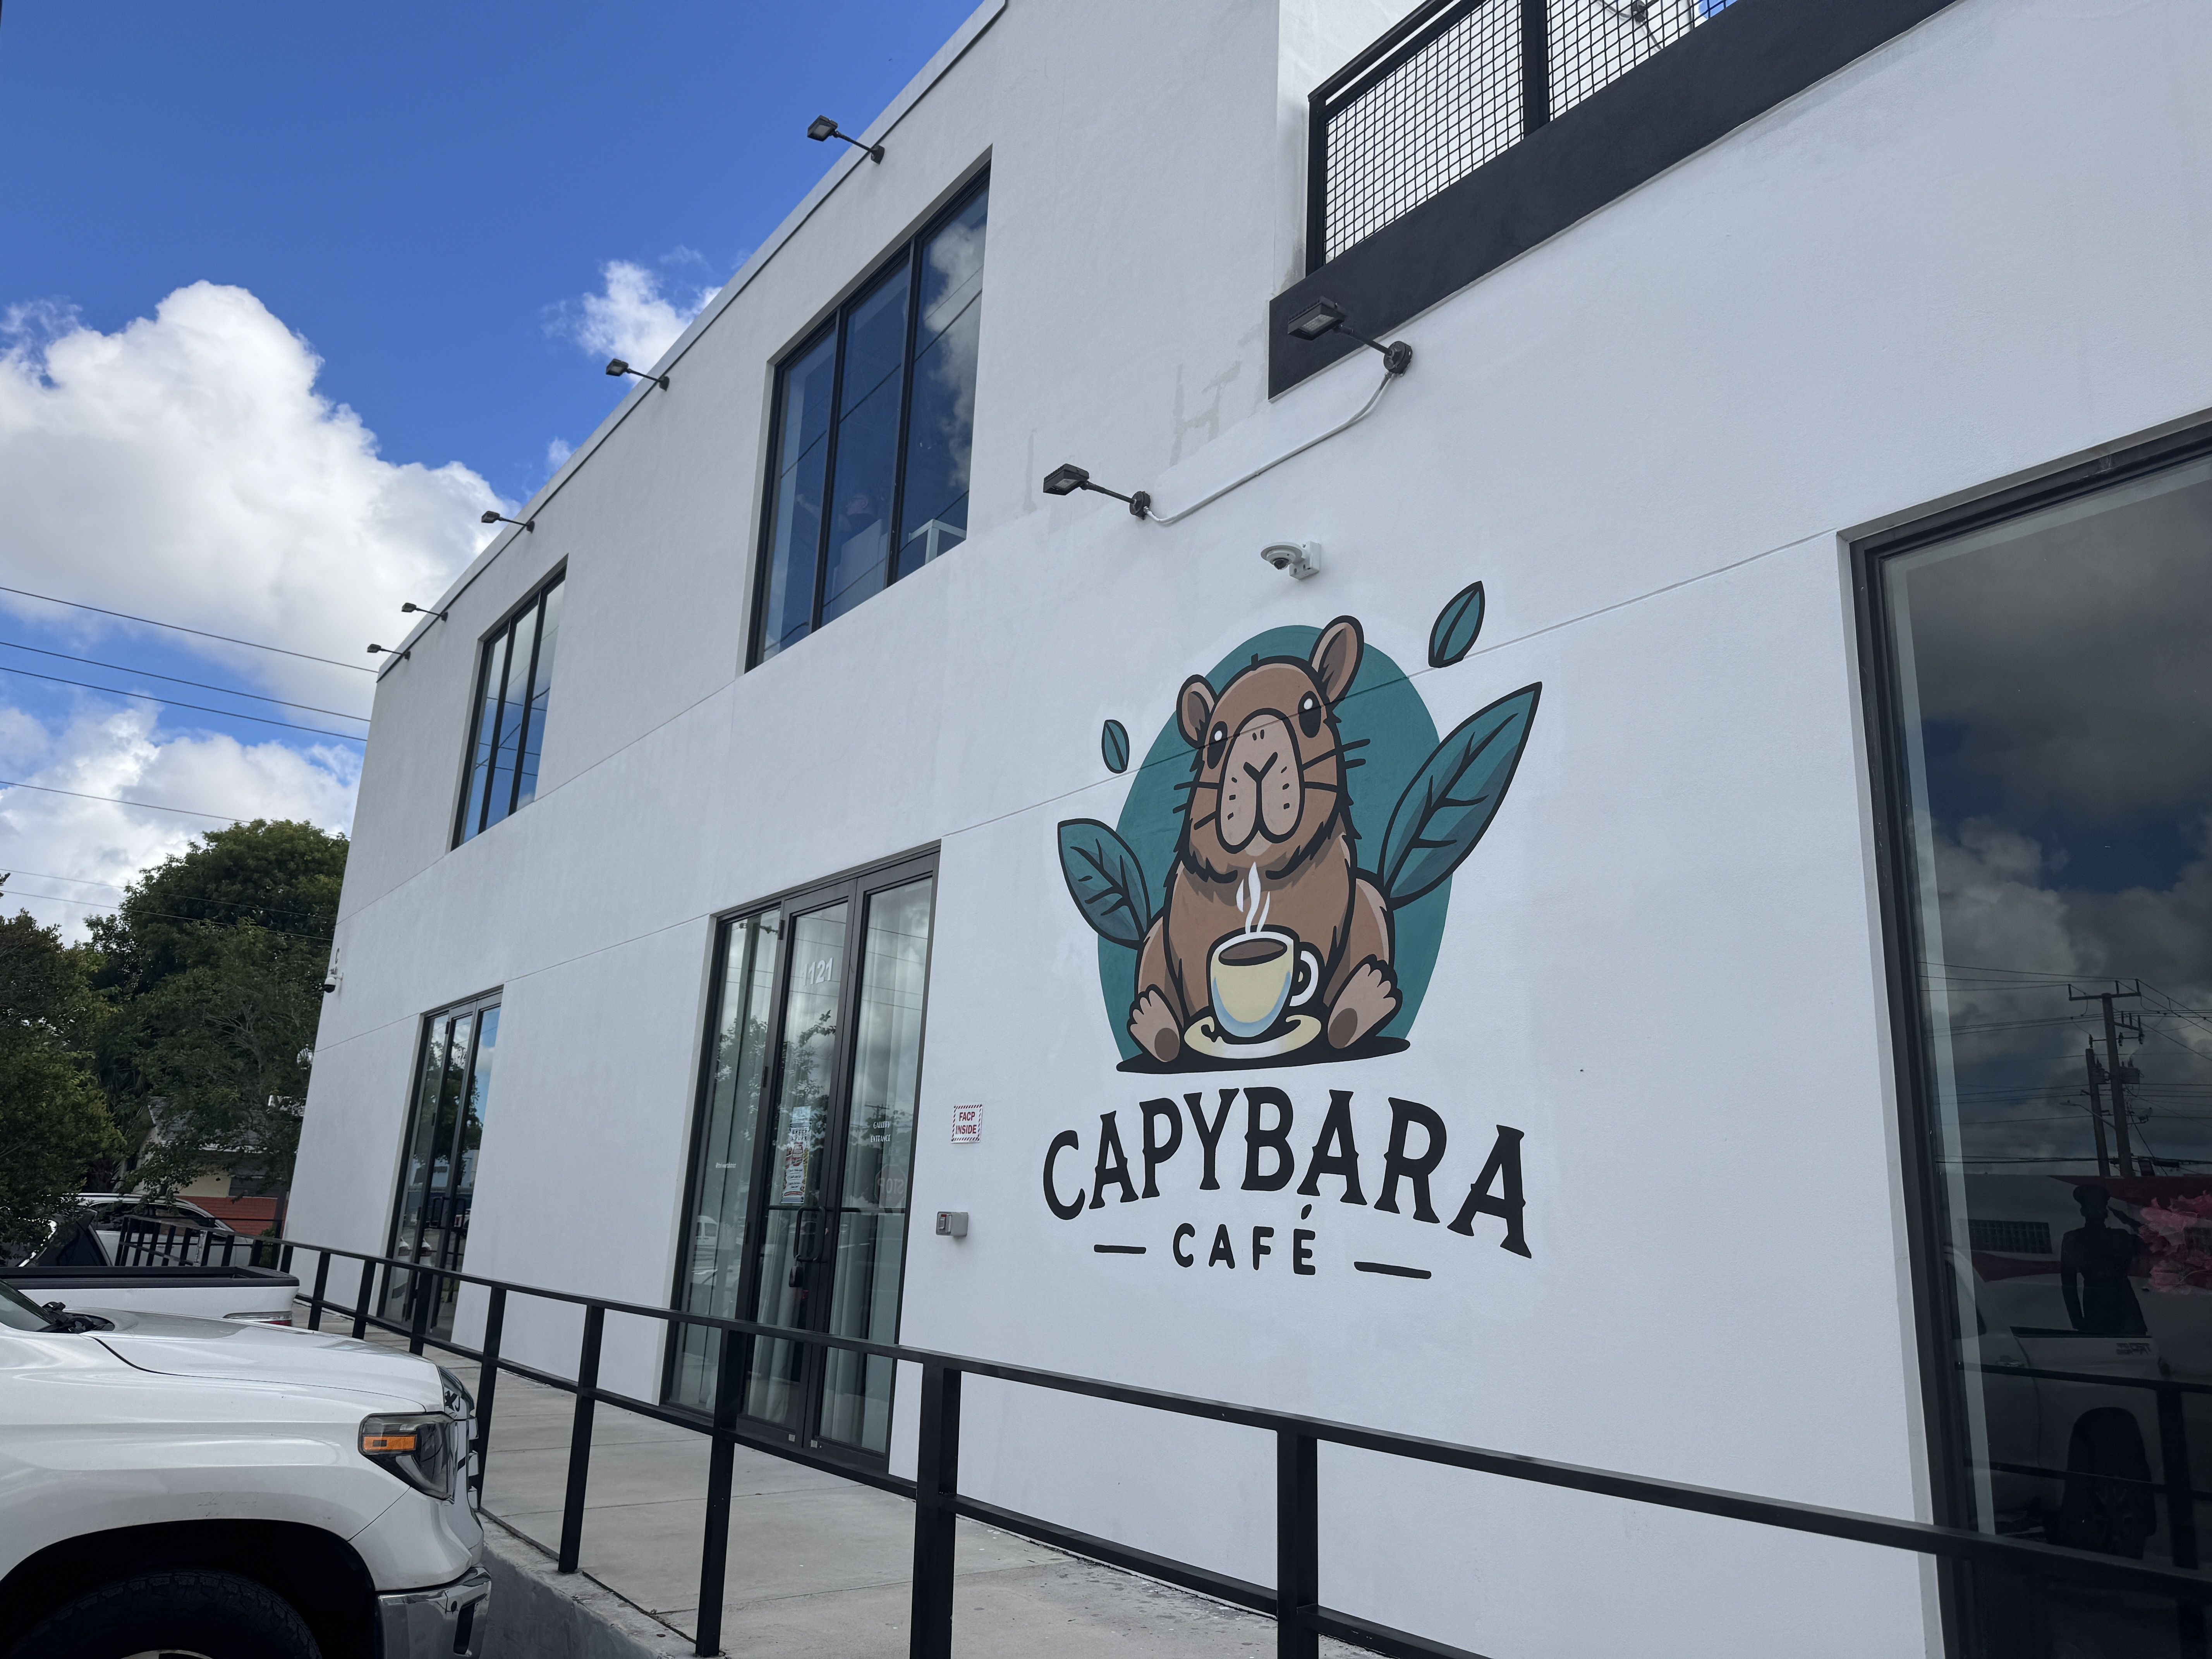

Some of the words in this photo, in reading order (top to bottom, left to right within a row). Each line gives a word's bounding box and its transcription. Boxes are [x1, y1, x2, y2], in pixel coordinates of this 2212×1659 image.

[802, 957, 833, 986] 1121
[959, 1112, 975, 1121] FACP
[871, 1134, 891, 1142] ENTRANCE
[955, 1125, 977, 1134] INSIDE
[1043, 1086, 1532, 1258] CAPYBARA
[1173, 1204, 1316, 1275] CAFÉ
